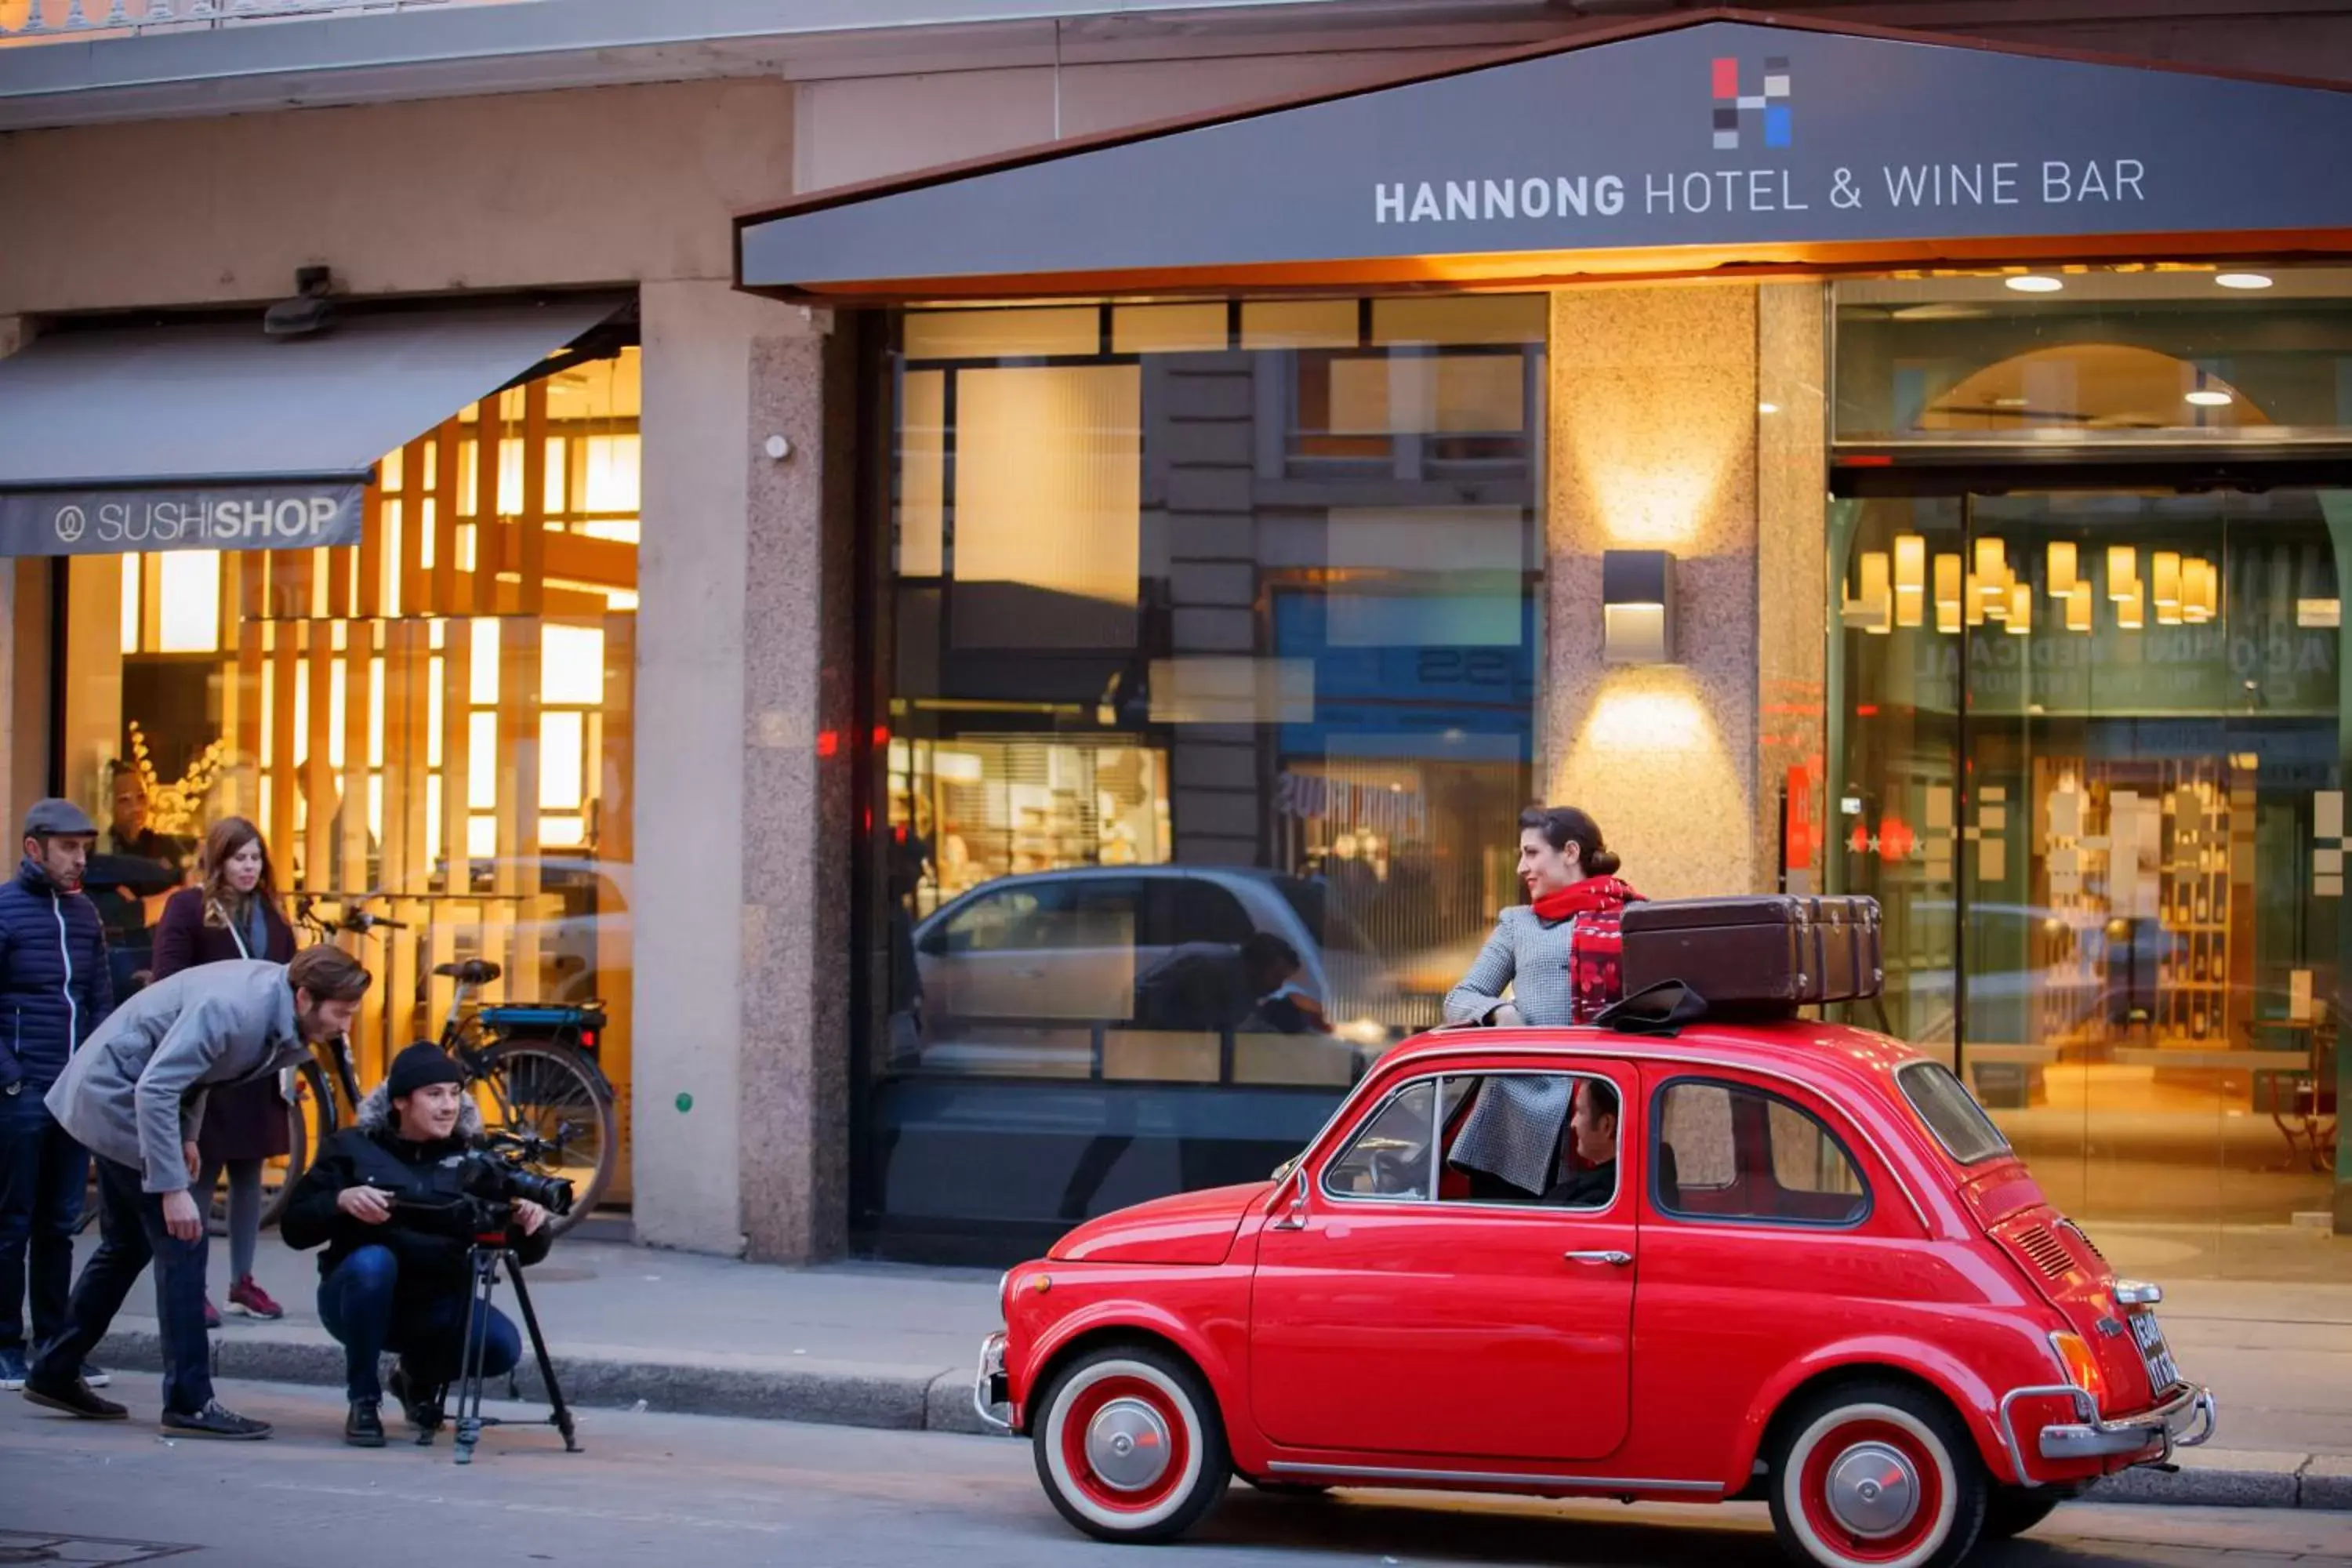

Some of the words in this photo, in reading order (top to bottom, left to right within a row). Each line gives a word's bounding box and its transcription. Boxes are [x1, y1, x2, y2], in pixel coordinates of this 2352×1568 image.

[1375, 175, 1624, 223] HANNONG
[1646, 170, 1808, 213] HOTEL
[1829, 166, 1862, 209] &
[1883, 162, 2019, 206] WINE
[2042, 159, 2145, 202] BAR
[97, 498, 337, 541] SUSHISHOP
